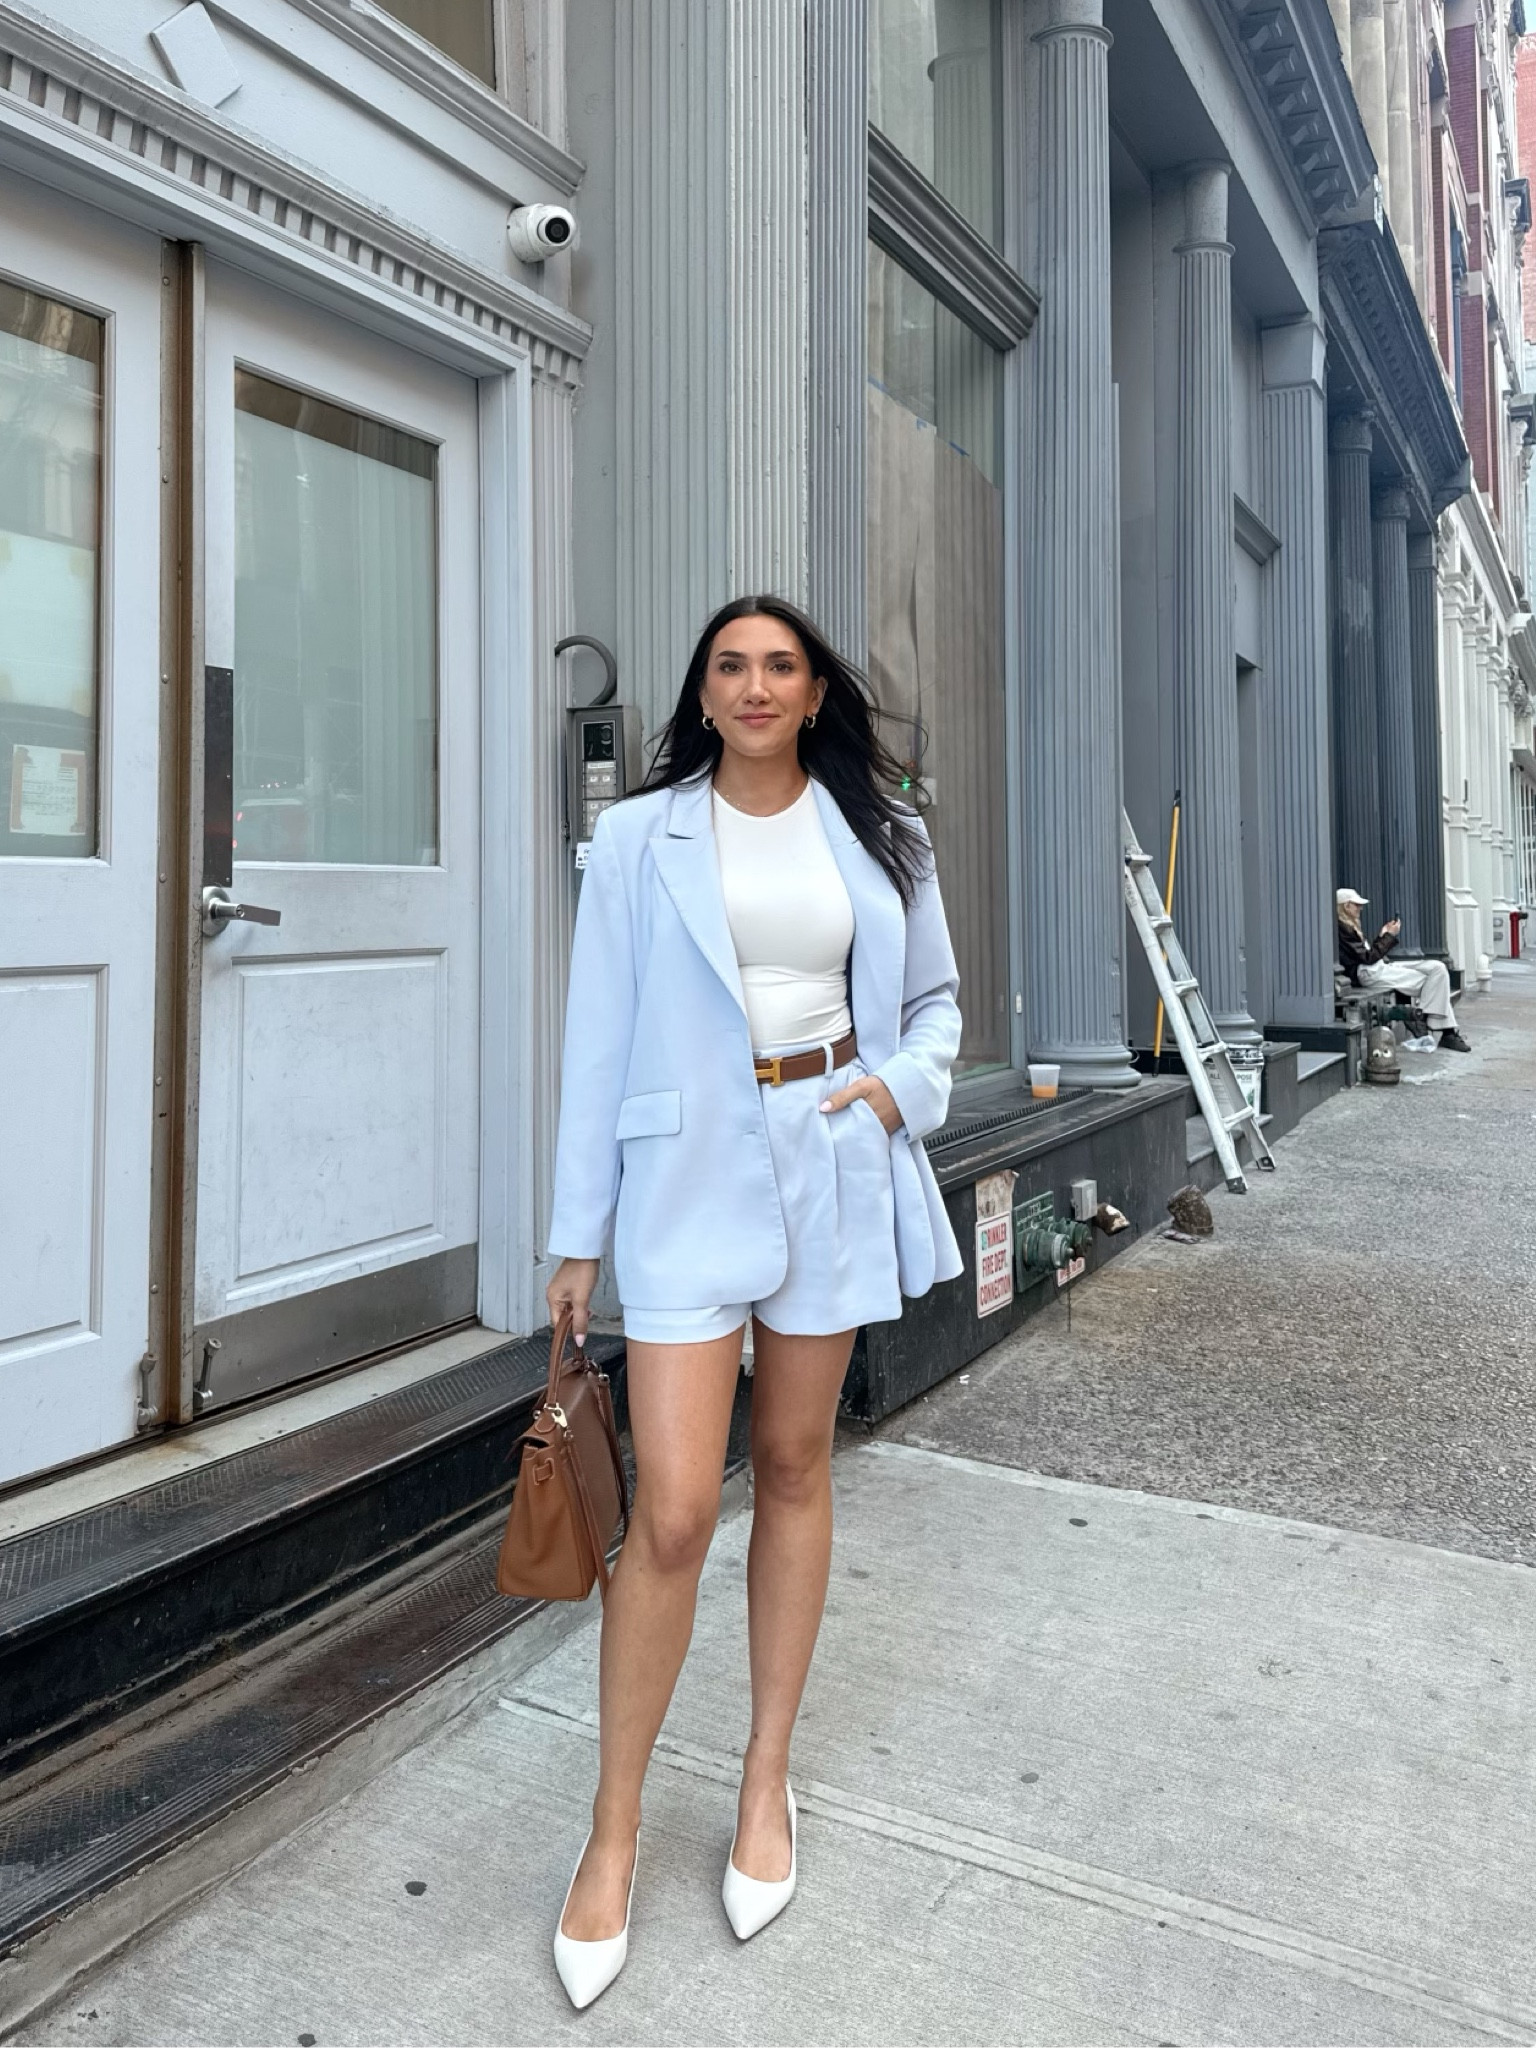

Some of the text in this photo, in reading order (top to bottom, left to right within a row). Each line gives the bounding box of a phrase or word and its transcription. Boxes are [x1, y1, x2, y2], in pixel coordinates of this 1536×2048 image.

[981, 1222, 1007, 1251] RINKLER
[982, 1254, 994, 1278] FIRE
[980, 1273, 1011, 1306] CONNECTION
